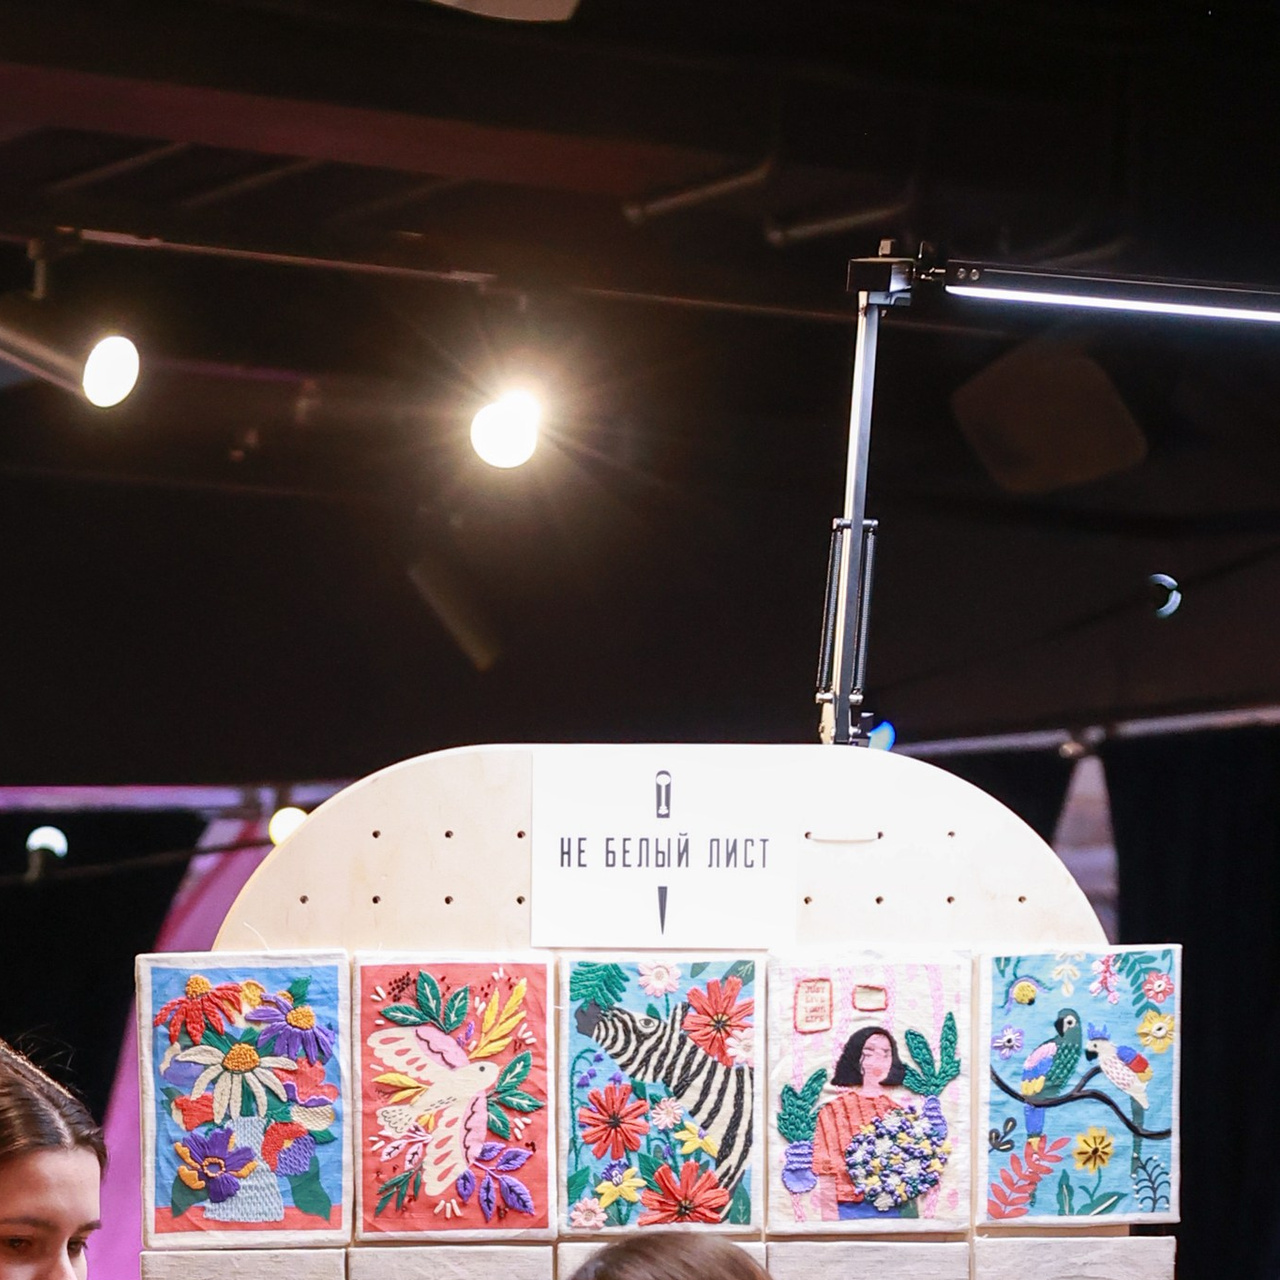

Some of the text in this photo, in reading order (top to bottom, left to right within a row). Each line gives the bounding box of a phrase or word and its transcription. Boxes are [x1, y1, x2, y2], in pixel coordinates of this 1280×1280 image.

[560, 833, 770, 868] НЕ БЕЛЫЙ ЛИСТ
